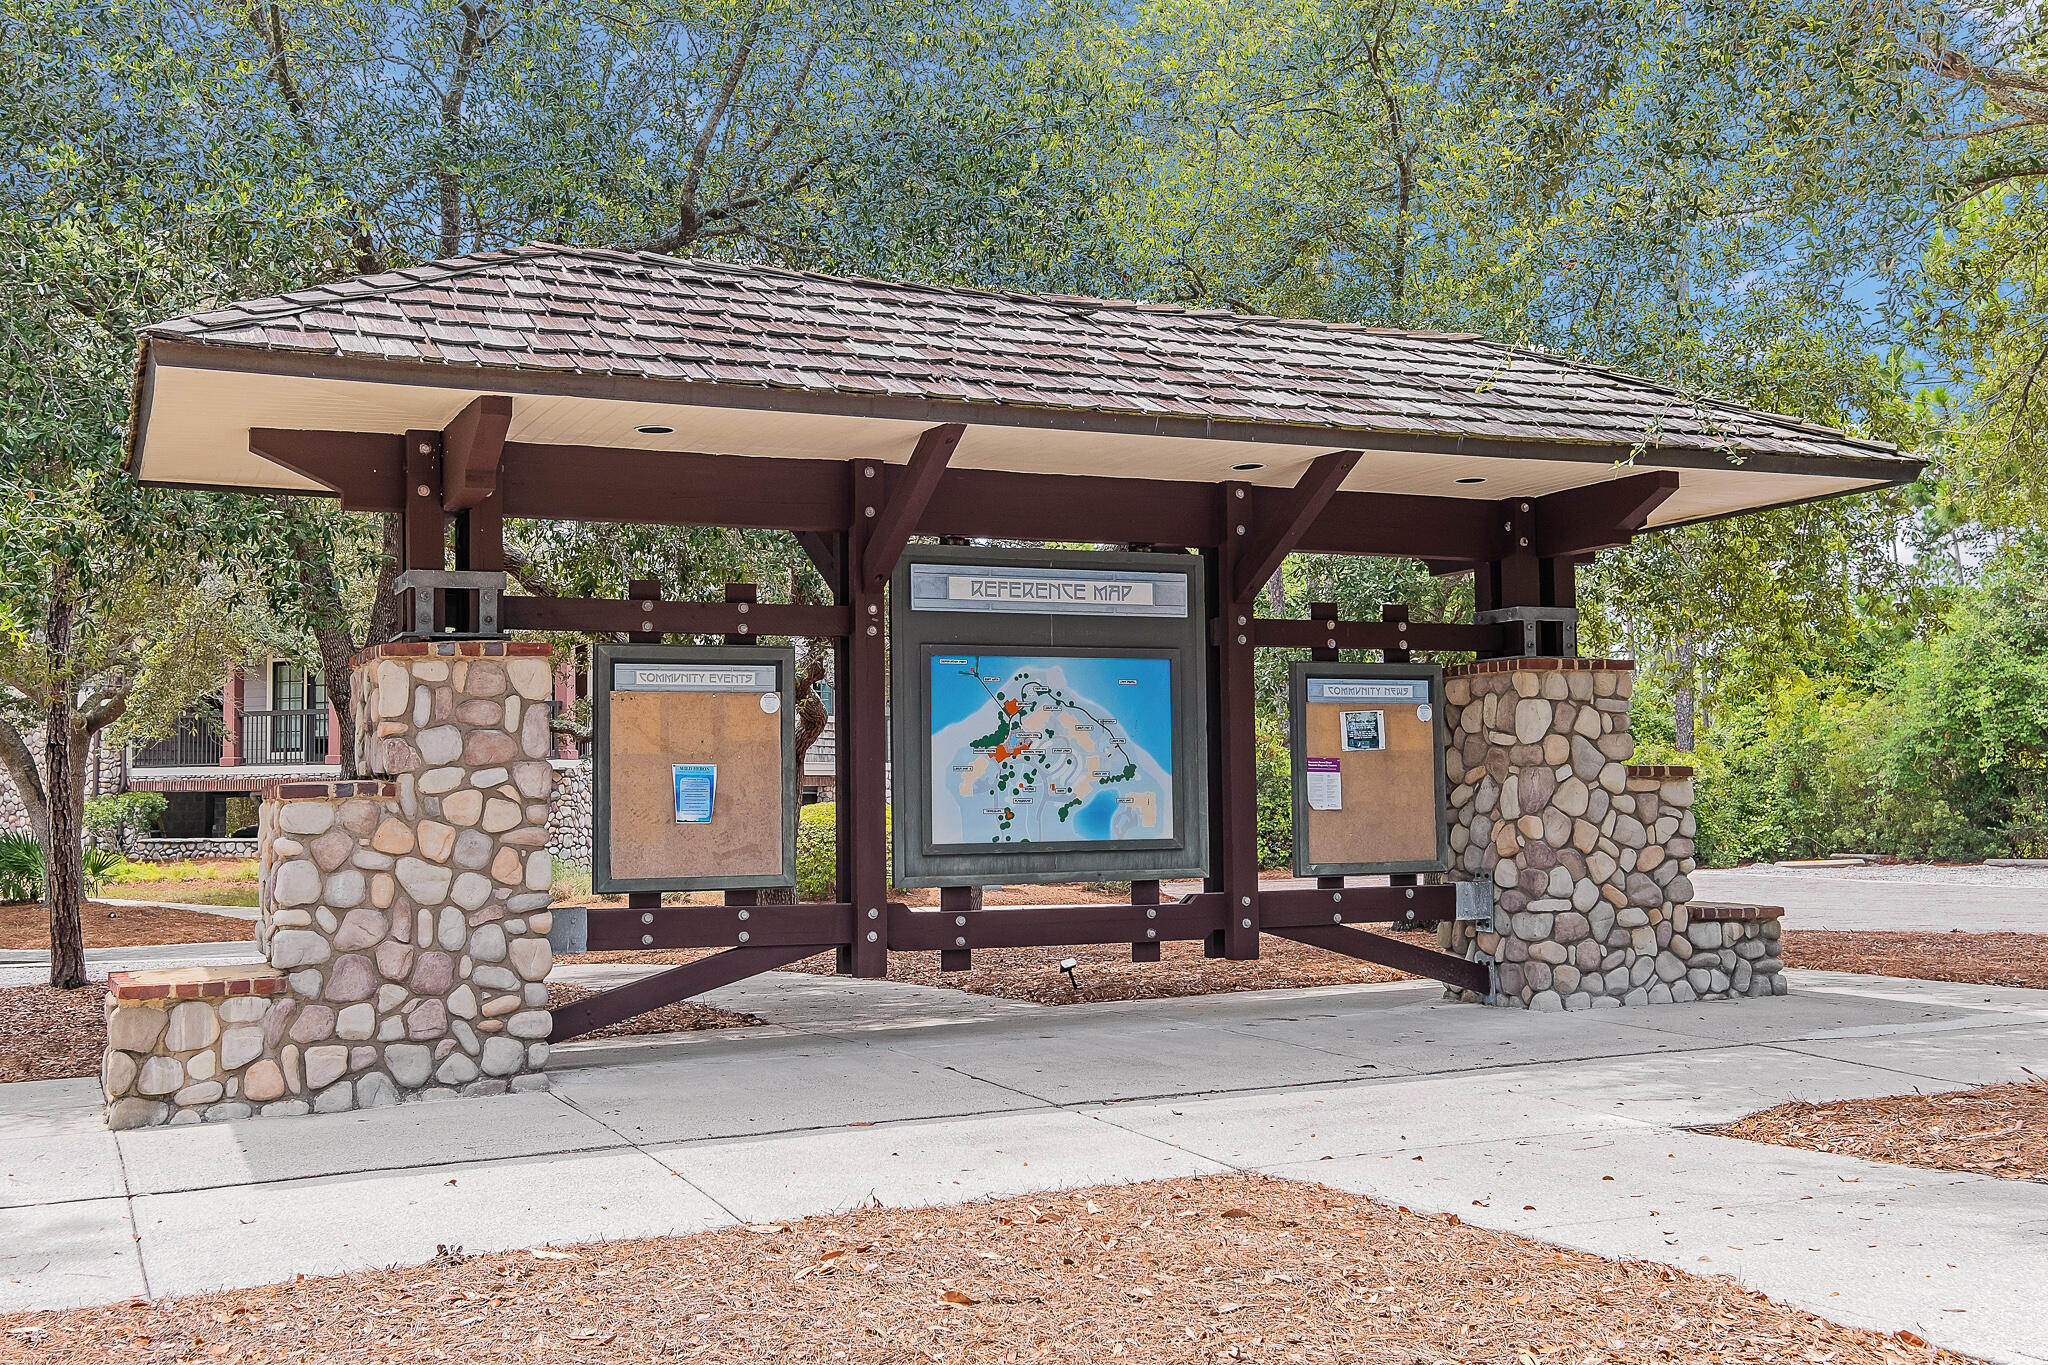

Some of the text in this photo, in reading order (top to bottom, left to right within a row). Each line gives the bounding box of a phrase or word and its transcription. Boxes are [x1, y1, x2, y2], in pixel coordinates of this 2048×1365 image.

[970, 580, 1133, 601] REFERENCE MAP
[709, 673, 753, 683] EVENTS
[1384, 687, 1409, 696] NEWS
